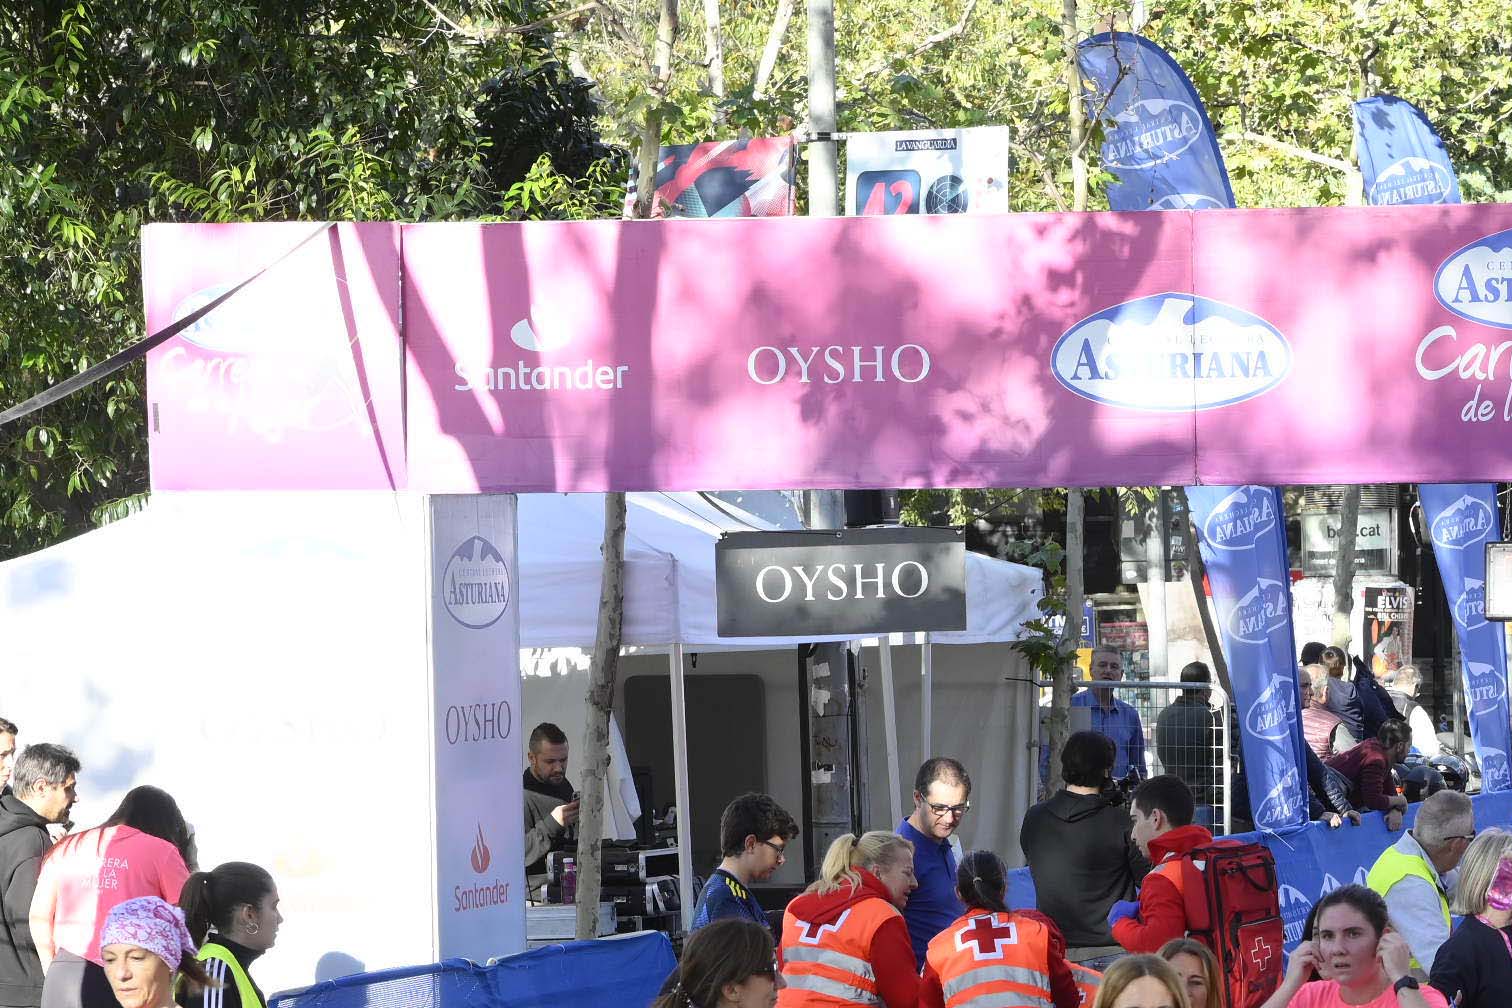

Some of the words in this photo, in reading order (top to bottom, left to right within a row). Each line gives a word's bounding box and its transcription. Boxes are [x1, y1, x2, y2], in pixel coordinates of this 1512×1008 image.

[907, 138, 956, 150] VANGUARDIA
[454, 359, 629, 393] Santander
[748, 343, 932, 385] OYSHO
[1461, 384, 1495, 422] de
[448, 571, 506, 606] ASTURIANA
[756, 559, 929, 604] OYSHO
[1377, 595, 1408, 609] ELVIS
[445, 700, 512, 745] OYSHO
[454, 880, 510, 912] Santander
